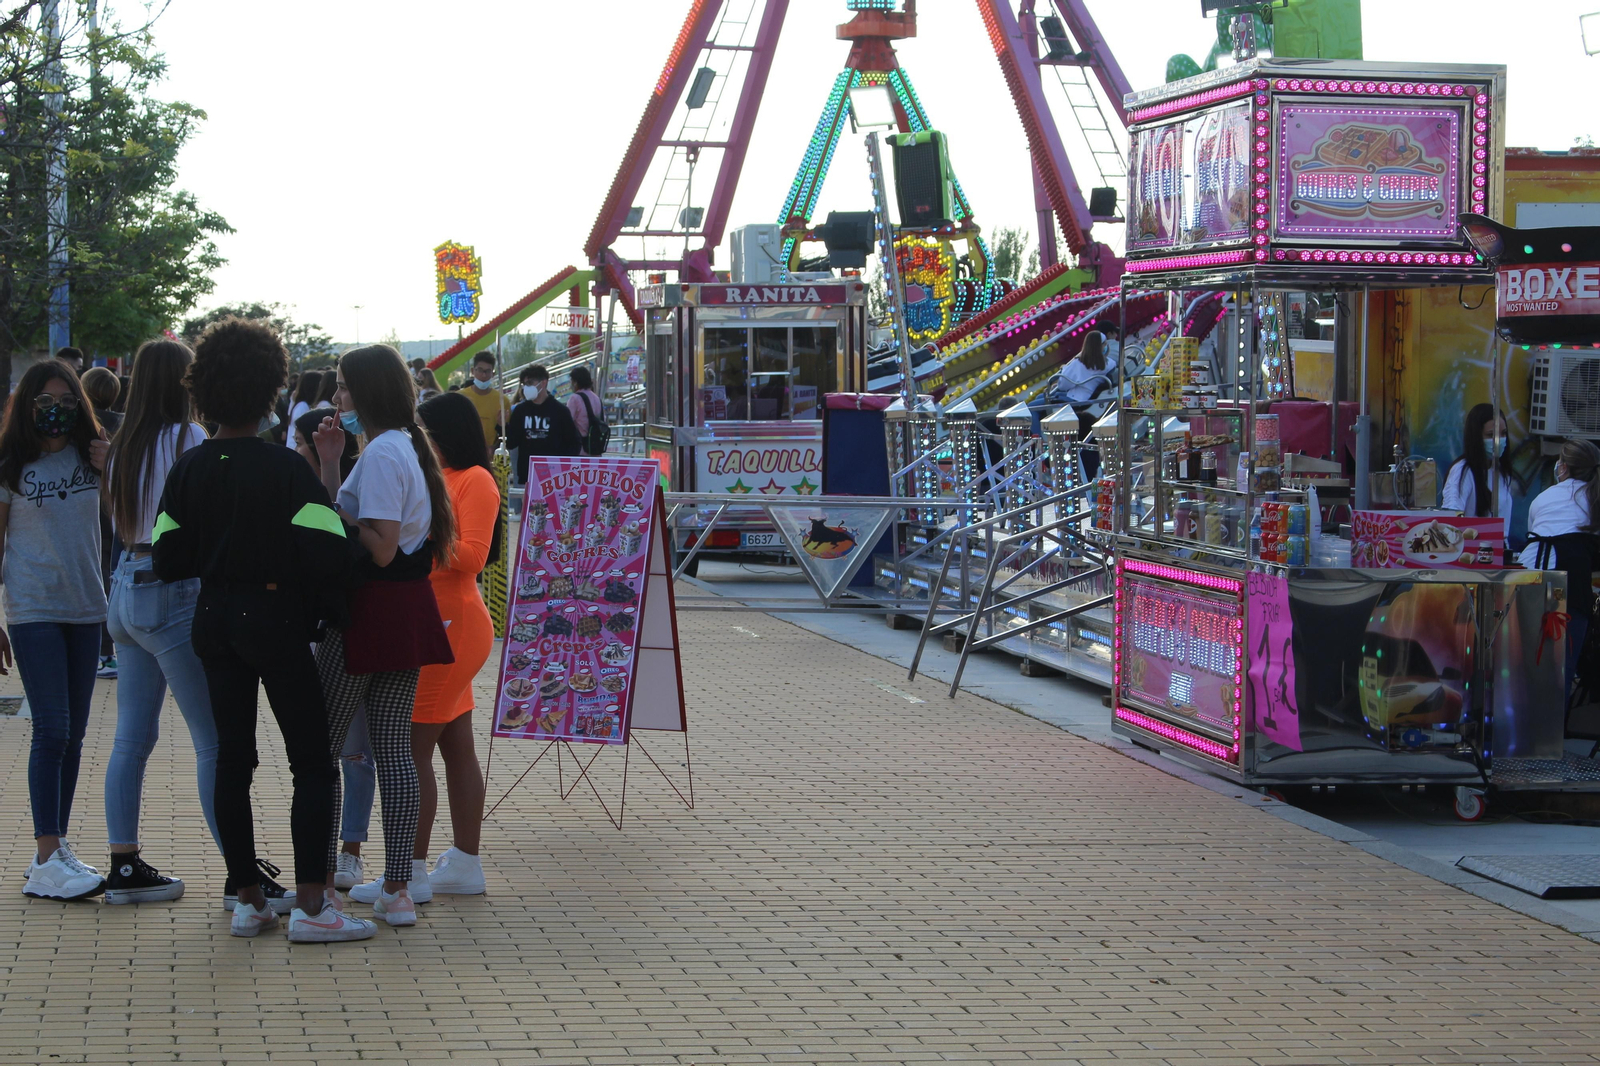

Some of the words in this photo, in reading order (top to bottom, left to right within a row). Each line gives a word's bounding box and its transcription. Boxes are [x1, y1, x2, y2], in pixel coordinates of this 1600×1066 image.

[1297, 173, 1358, 199] GOFRES
[1378, 175, 1439, 200] CREPES
[725, 287, 821, 302] RANITA
[1506, 267, 1600, 302] BOXE
[1505, 303, 1522, 312] MOST
[1522, 302, 1558, 312] WANTED
[524, 415, 550, 430] NYC
[24, 466, 97, 508] Sparkle
[540, 466, 646, 500] BUÑUELOS
[1353, 514, 1391, 540] Crepes
[748, 535, 774, 545] 6637
[546, 545, 619, 563] GOFRES
[1247, 572, 1278, 597] BEBIDA
[540, 638, 604, 656] Crepes
